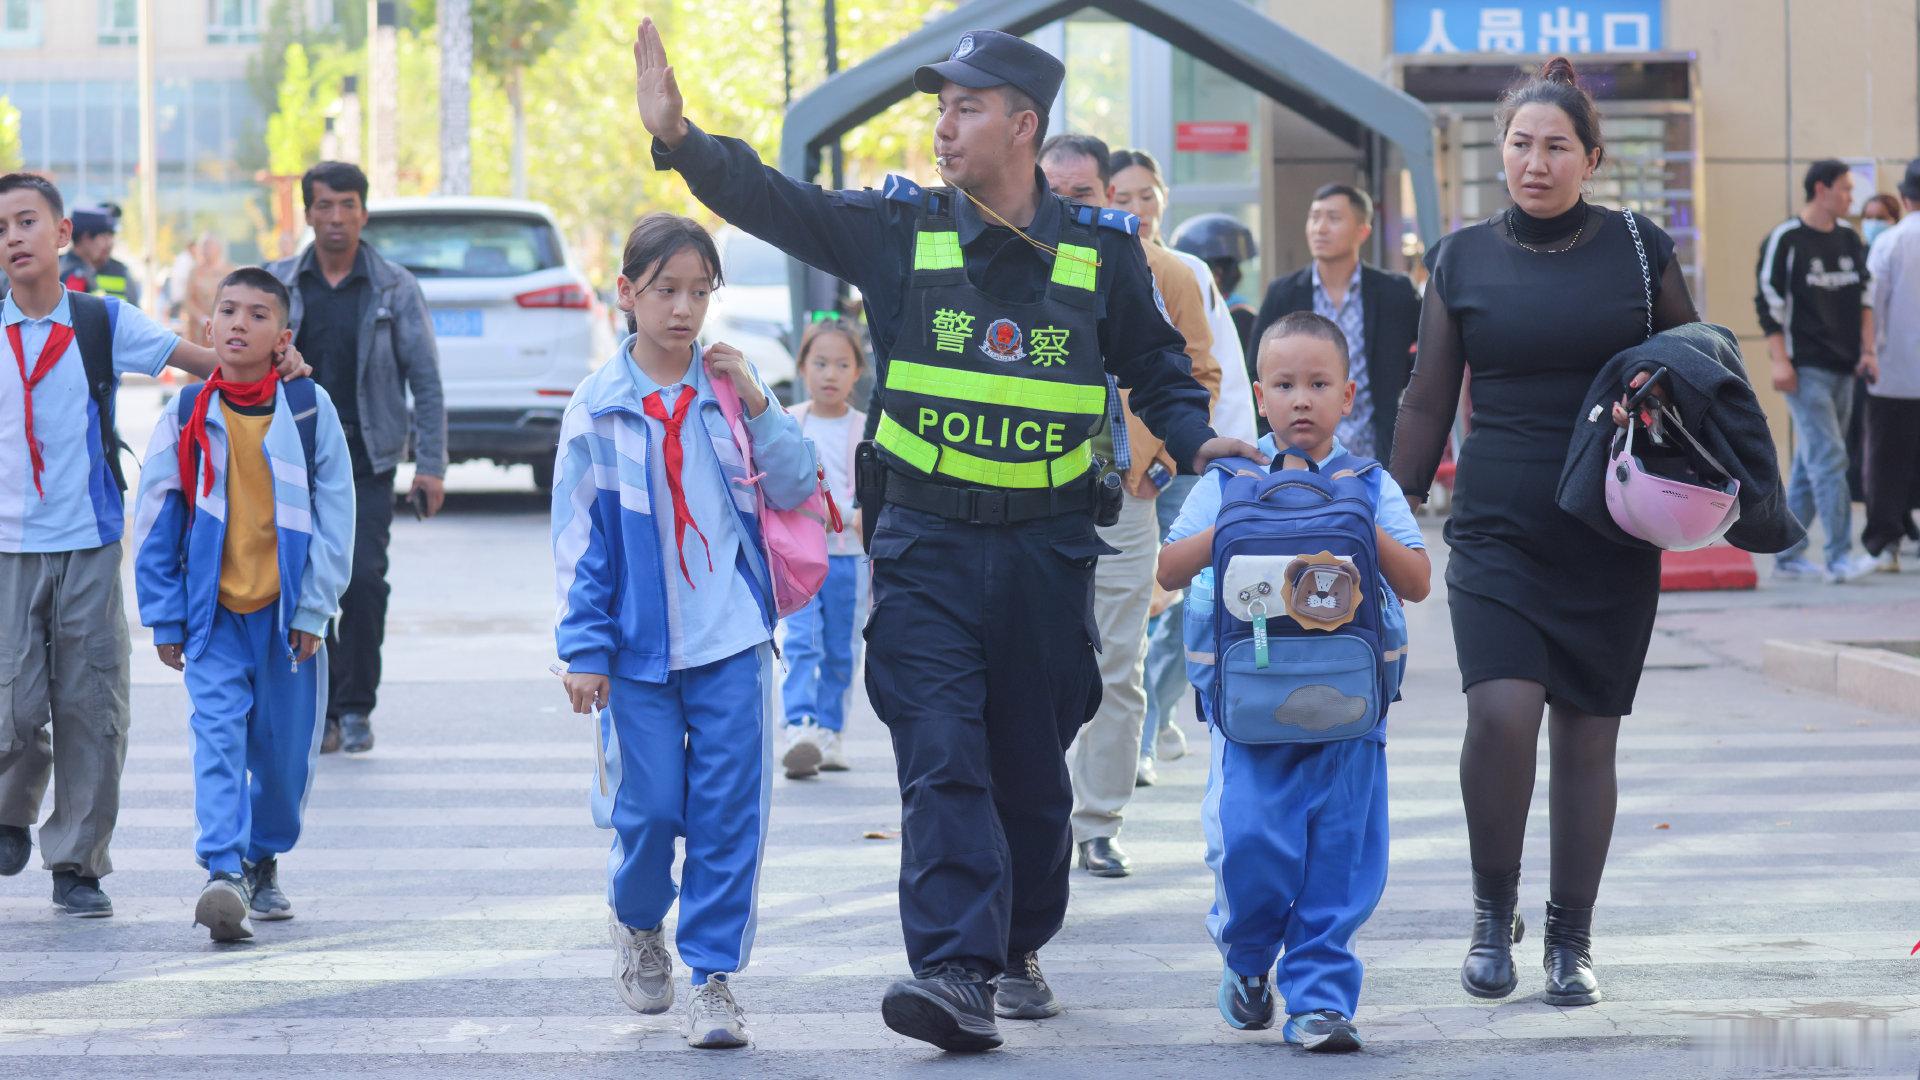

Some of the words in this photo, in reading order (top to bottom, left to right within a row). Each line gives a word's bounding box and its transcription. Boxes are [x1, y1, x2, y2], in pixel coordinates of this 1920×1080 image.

[1417, 7, 1651, 53] 人员出口
[918, 407, 1066, 453] POLICE
